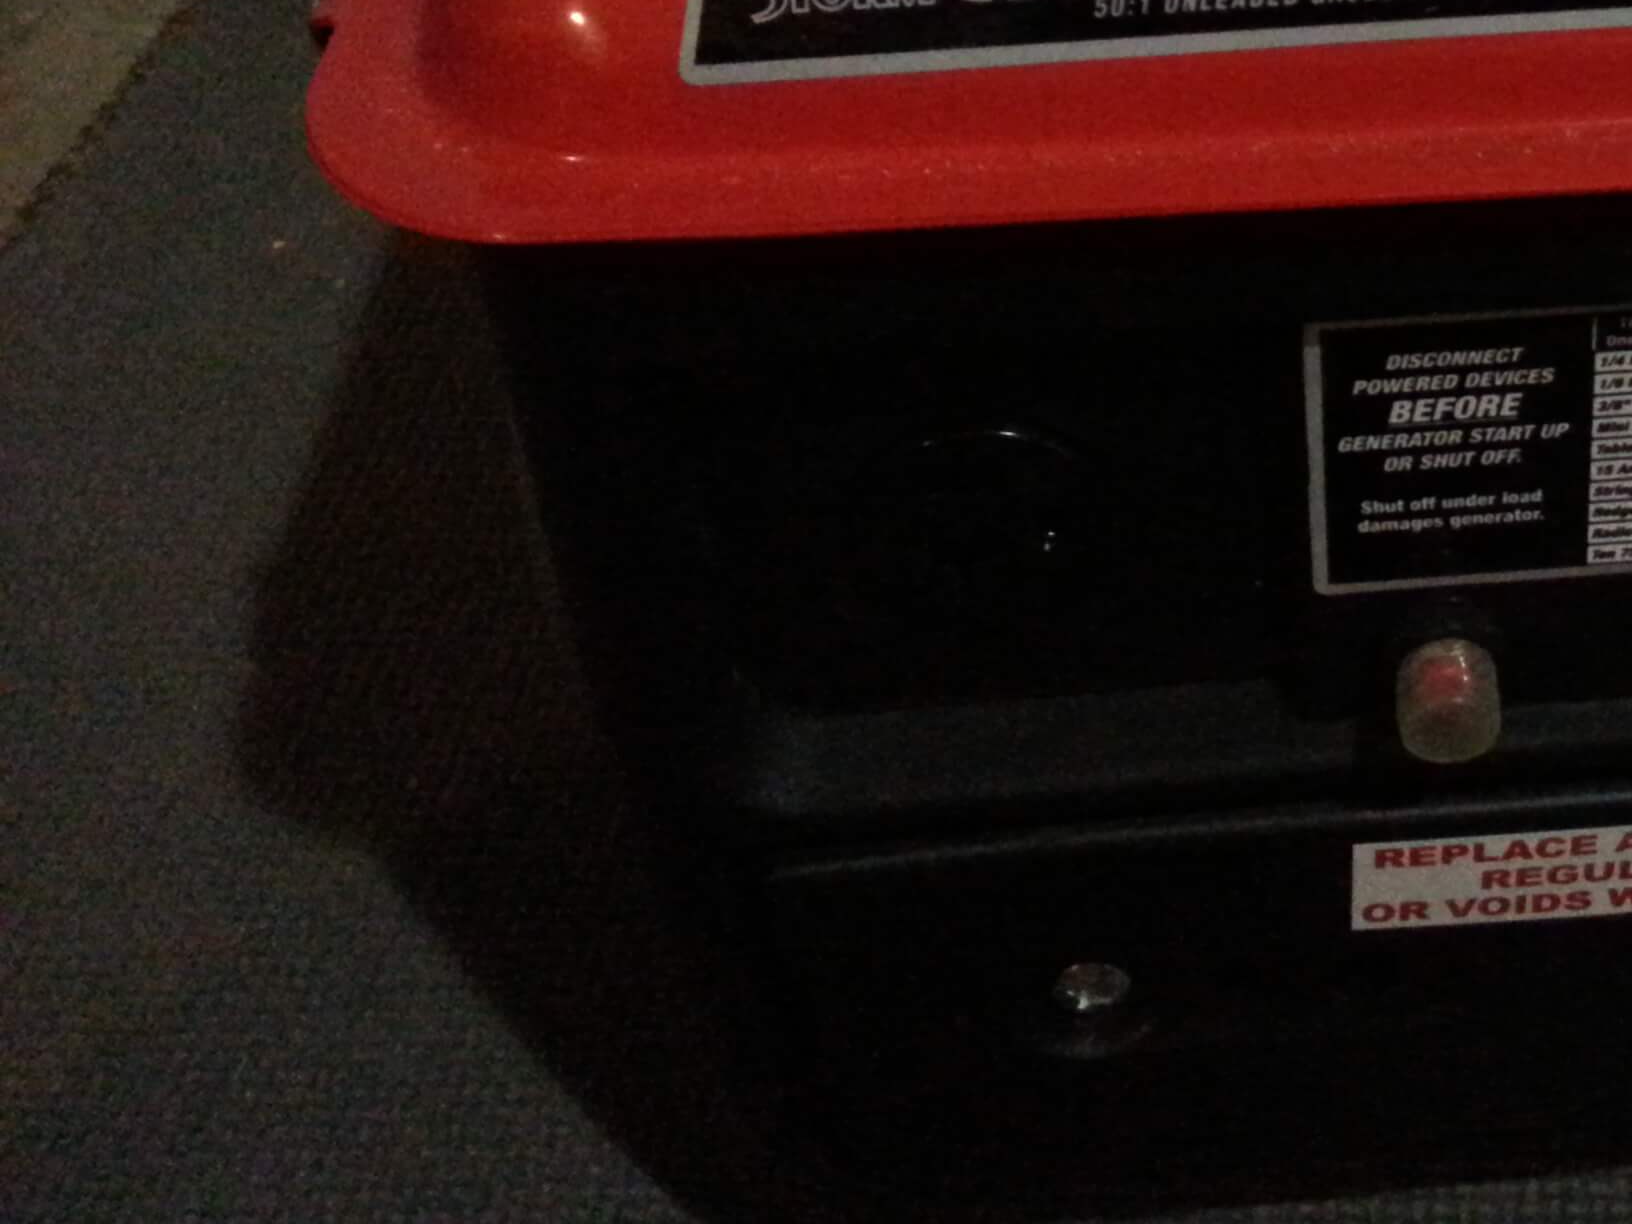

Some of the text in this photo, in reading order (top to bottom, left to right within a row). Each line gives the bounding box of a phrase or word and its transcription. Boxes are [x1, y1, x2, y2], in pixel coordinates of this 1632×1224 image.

[1385, 346, 1526, 371] DISCONNECT
[1352, 367, 1556, 396] POWERED DEVICES
[1387, 392, 1524, 424] BEFORE
[1337, 422, 1570, 454] GENERATOR START UP
[1384, 448, 1522, 473] OR SHUT OFF.
[1360, 488, 1544, 515] Shut off under load
[1357, 508, 1545, 534] damages generator.
[1375, 834, 1598, 869] REPLACE
[1362, 900, 1430, 923] OR
[1445, 890, 1592, 918] VOIDS
